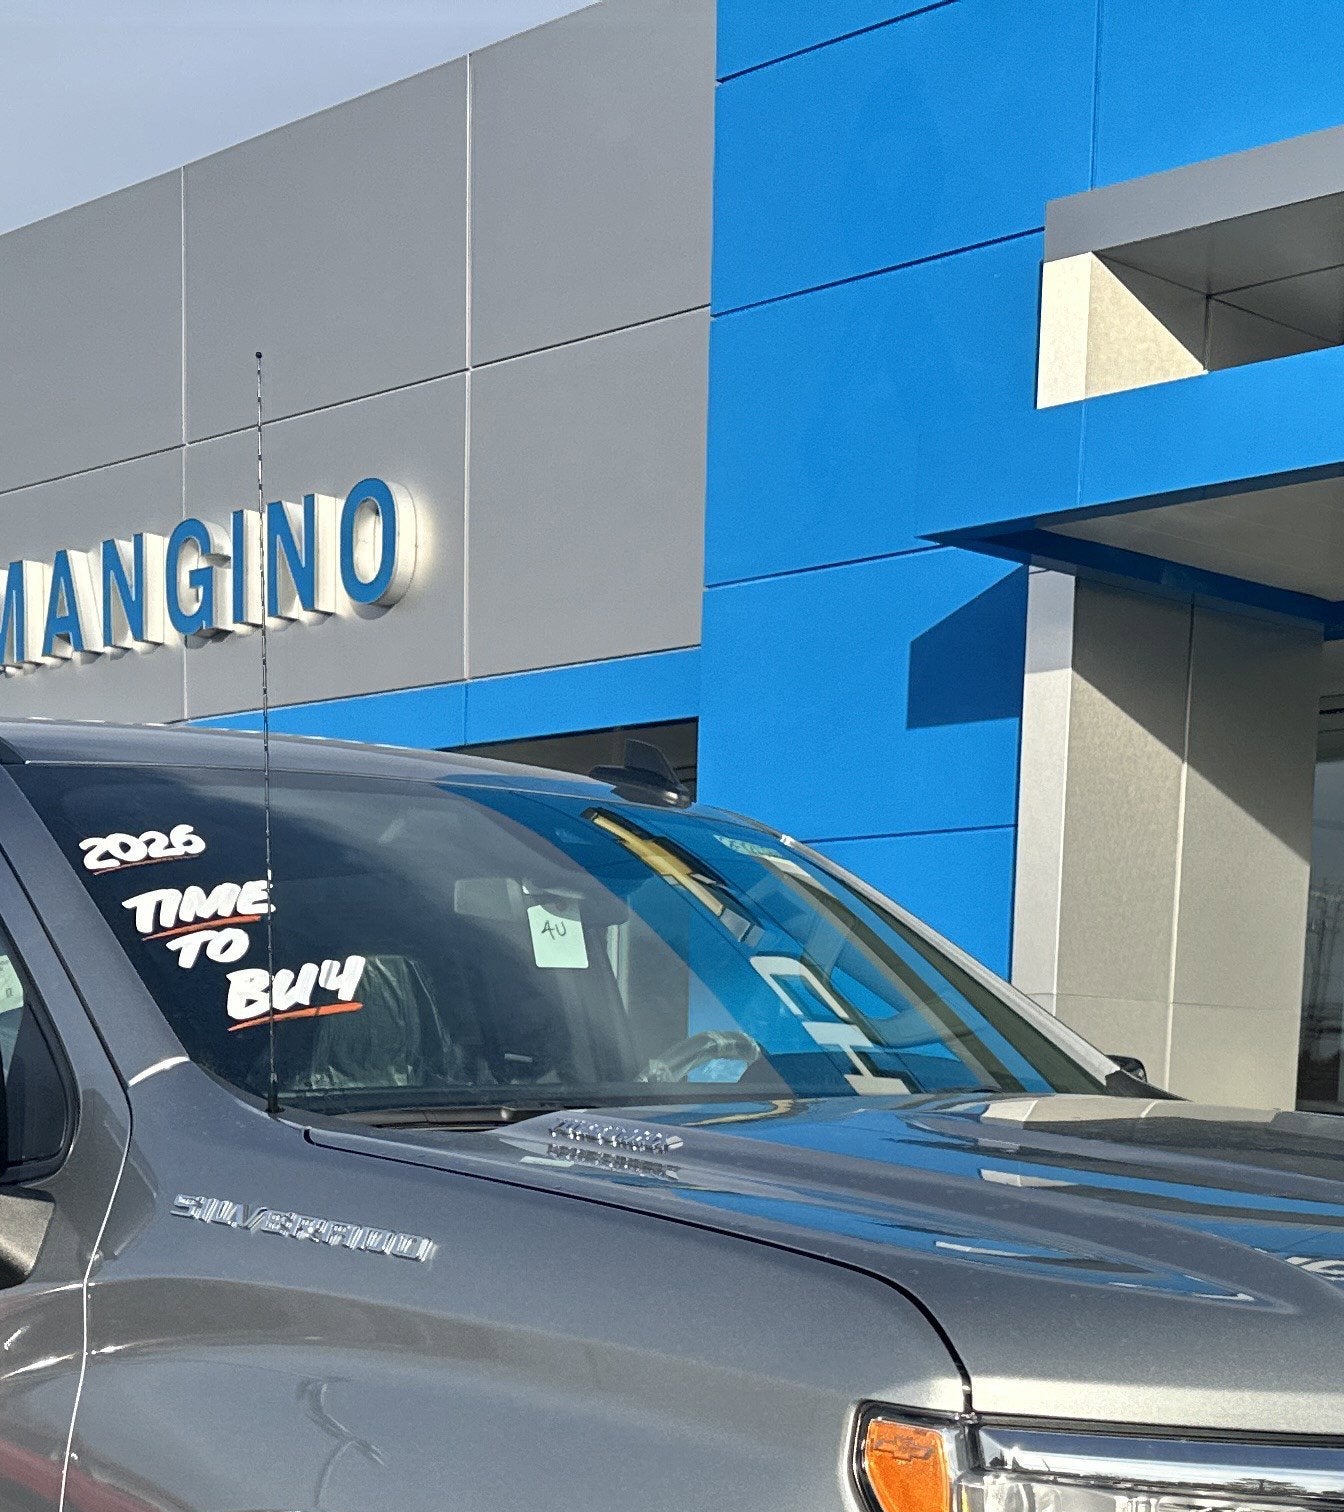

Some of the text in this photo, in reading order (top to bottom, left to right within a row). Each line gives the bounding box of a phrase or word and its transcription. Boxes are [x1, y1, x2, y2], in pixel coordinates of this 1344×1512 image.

[79, 824, 206, 870] 2026
[122, 880, 276, 933] TIME
[166, 928, 249, 969] TO
[227, 955, 366, 1020] BUY
[170, 1193, 434, 1262] SILVERADO
